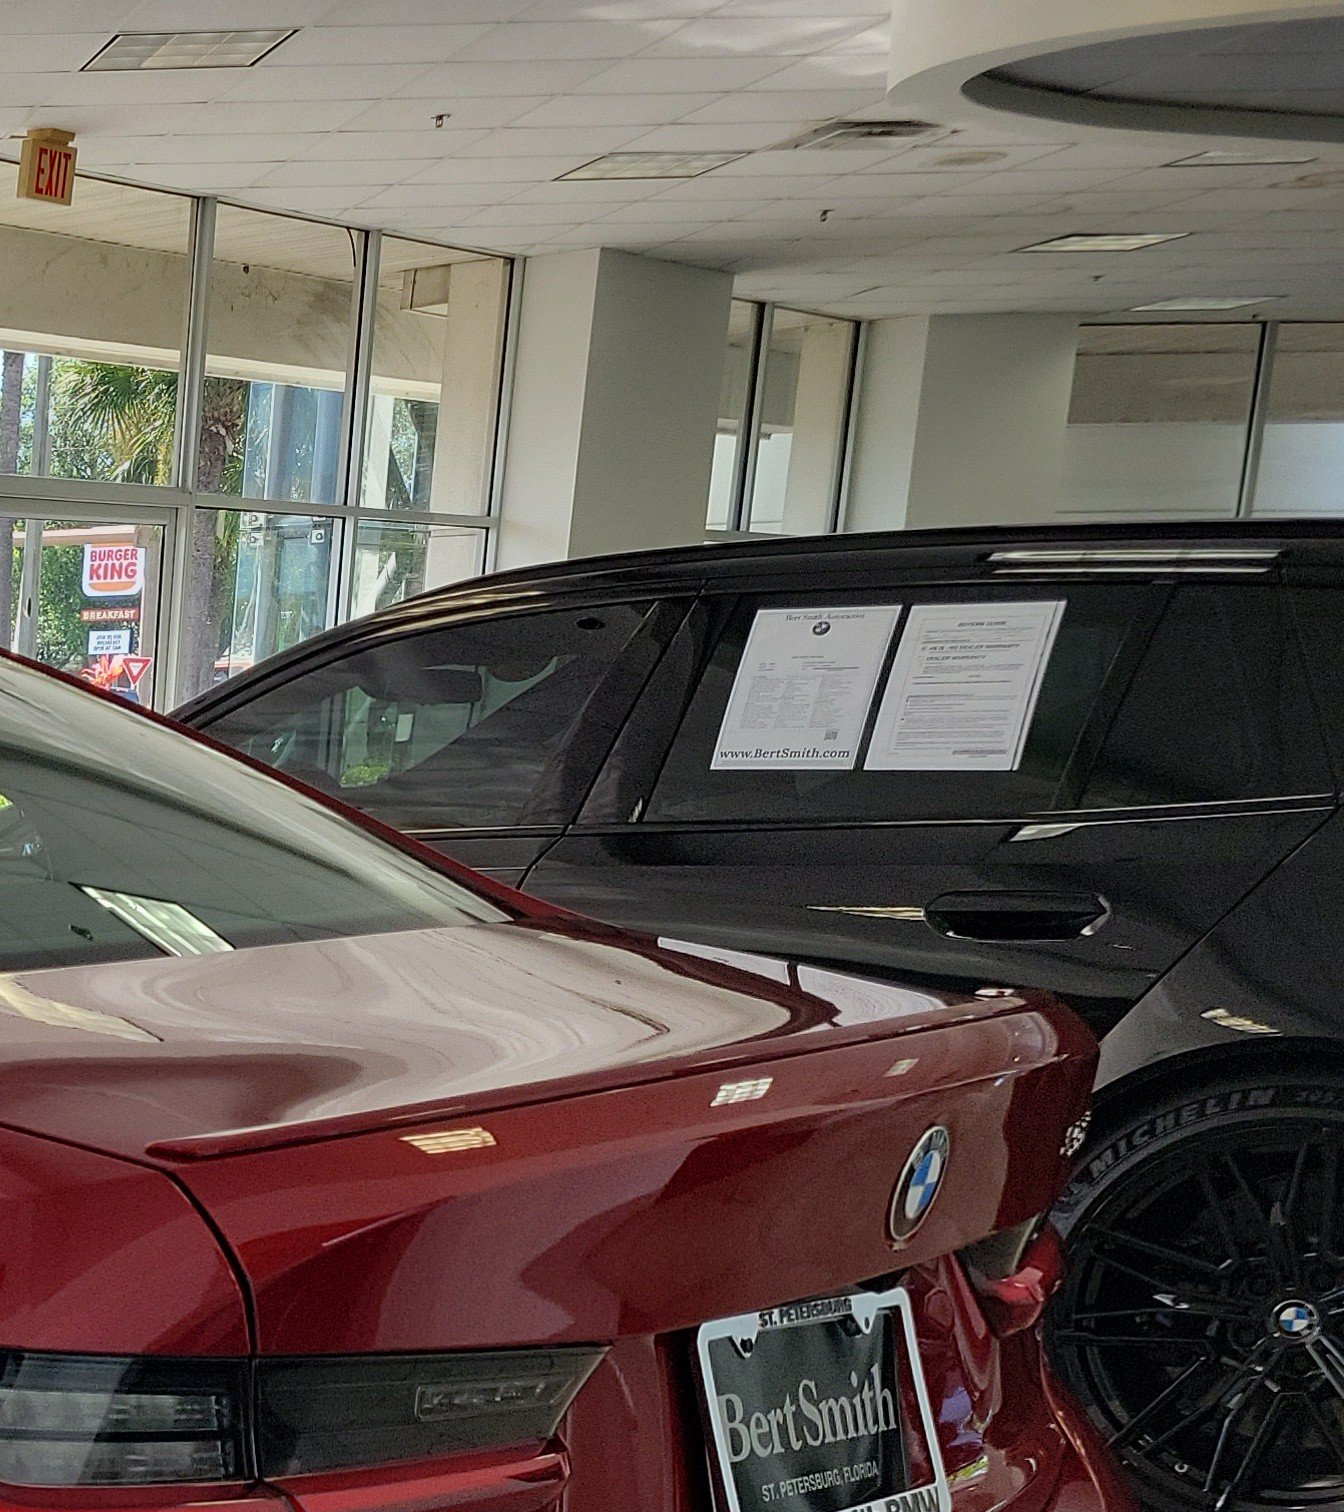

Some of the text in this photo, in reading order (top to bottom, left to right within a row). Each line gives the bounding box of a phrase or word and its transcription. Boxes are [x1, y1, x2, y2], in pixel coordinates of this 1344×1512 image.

[34, 147, 72, 199] EXIT
[89, 548, 139, 563] BURGER
[88, 561, 138, 582] KING
[82, 609, 136, 622] BREAKFAST
[719, 747, 850, 759] www.BertSmith.com
[1089, 1088, 1276, 1178] MICHELIN
[762, 1483, 780, 1502] ST.
[843, 1459, 880, 1483] FLORIDA
